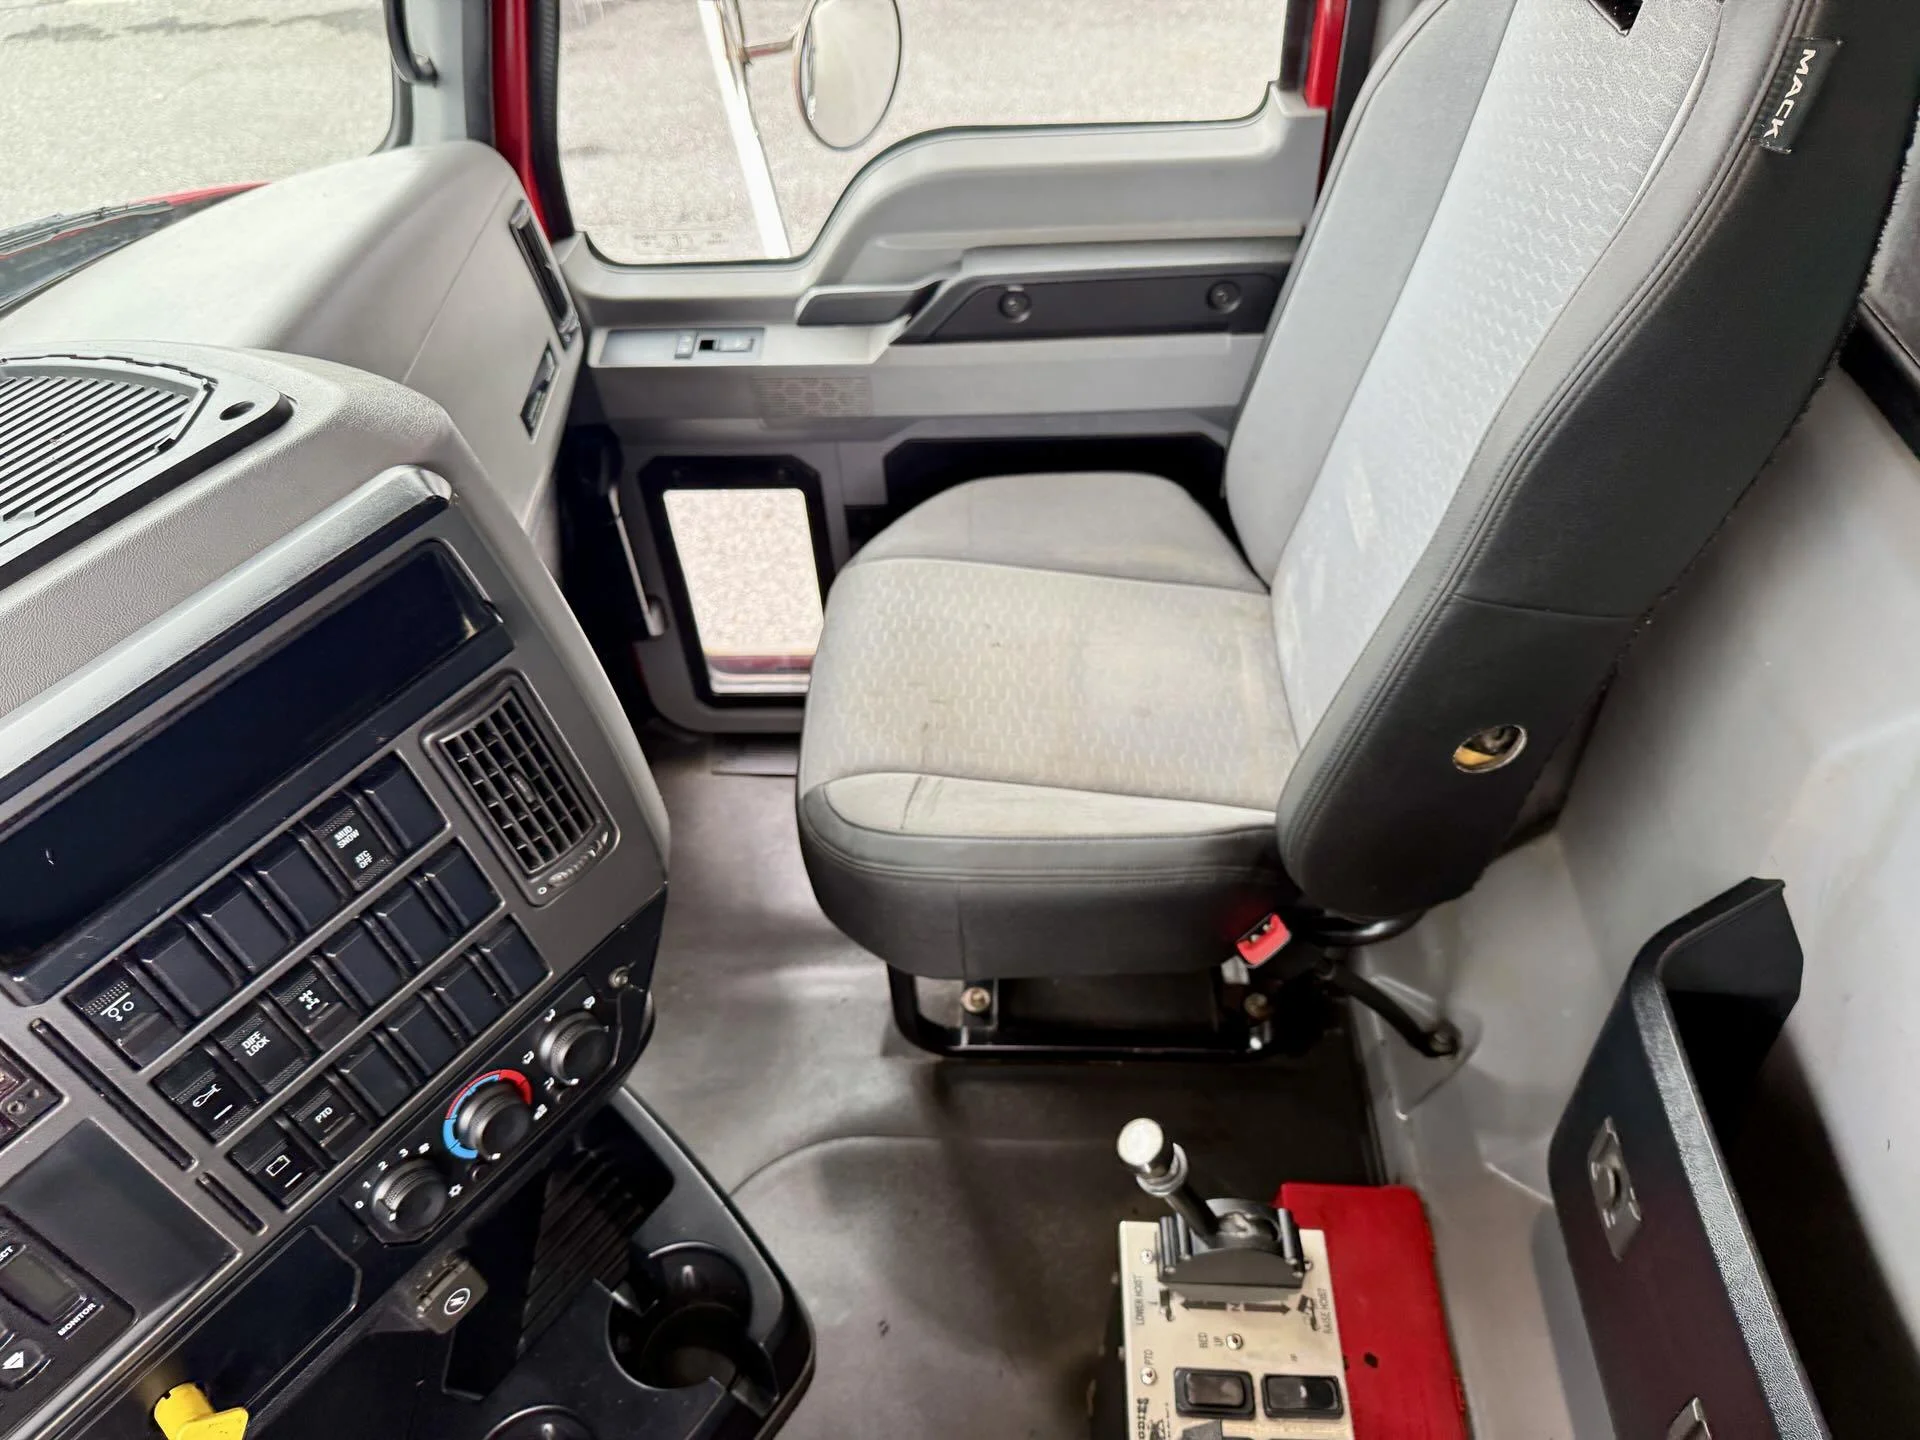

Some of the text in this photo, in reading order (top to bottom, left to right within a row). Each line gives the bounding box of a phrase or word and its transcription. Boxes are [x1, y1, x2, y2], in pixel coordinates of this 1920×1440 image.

[1763, 48, 1816, 139] MACK
[334, 825, 353, 841] MUD
[337, 829, 360, 849] SNOW
[355, 850, 370, 863] ATC
[359, 855, 373, 869] OFF
[241, 1030, 261, 1049] DIFF
[245, 1036, 271, 1057] LOCK
[314, 1106, 333, 1123] PTO
[378, 1161, 388, 1171] 2
[57, 1302, 97, 1337] MONITOR
[1134, 1299, 1145, 1326] LOWER
[1320, 1311, 1333, 1334] RAISE
[1143, 1348, 1153, 1366] PTO
